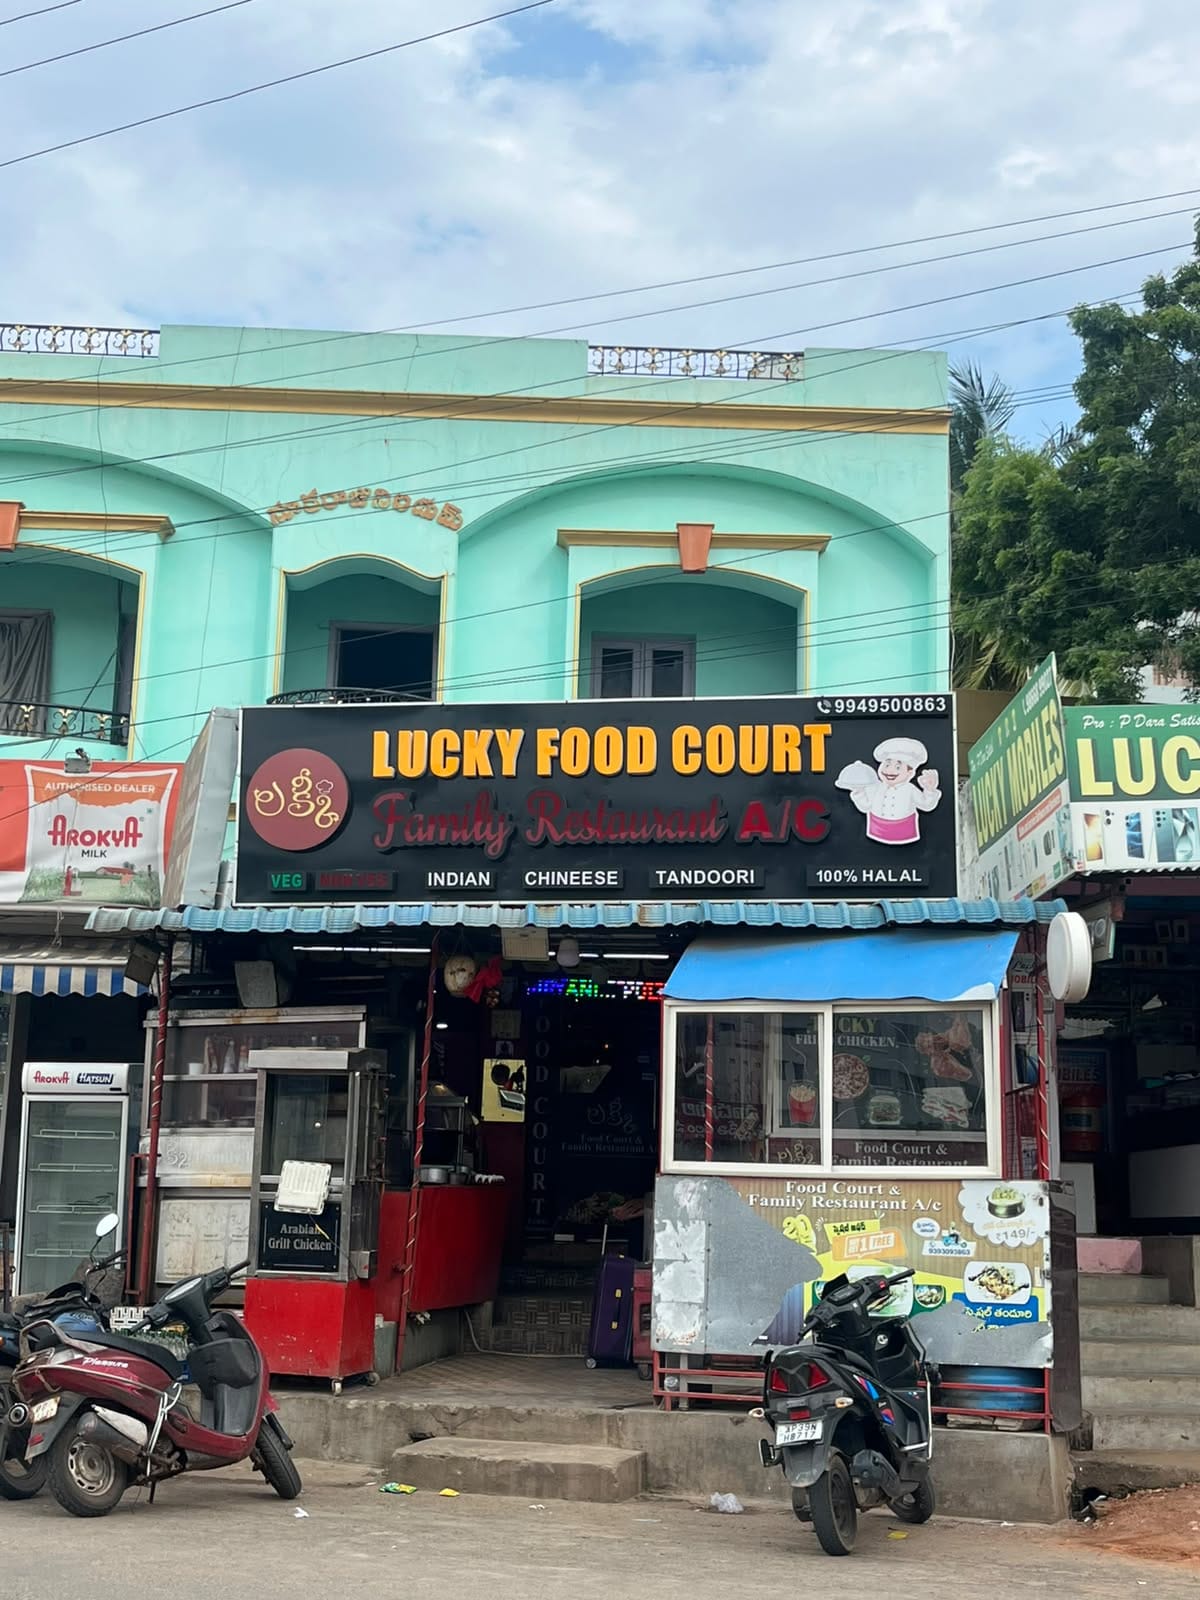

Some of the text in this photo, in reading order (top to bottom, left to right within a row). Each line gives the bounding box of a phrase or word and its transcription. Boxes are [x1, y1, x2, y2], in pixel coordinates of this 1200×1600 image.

[835, 697, 947, 713] 9949500863
[1083, 715, 1105, 729] Pro
[372, 723, 832, 778] LUCKY FOOD COURT
[972, 757, 1009, 844] LUCKY
[1006, 700, 1065, 816] MOBILES
[1076, 736, 1200, 797] LUC
[45, 781, 155, 793] AUTHORISED DEALER
[373, 790, 830, 857] Family Restaurant A/C
[81, 849, 107, 858] MILK
[271, 873, 303, 888] VEG
[428, 871, 491, 887] INDIAN
[525, 870, 619, 886] CHINEESE
[656, 870, 755, 885] TANDOORI
[816, 868, 922, 883] 100% HALAL
[78, 1072, 113, 1085] HATSUN
[855, 1141, 949, 1156] Food Court &
[786, 1181, 902, 1196] Food Court &
[748, 1193, 943, 1213] Family Restaurant A/c
[280, 1223, 321, 1235] Arabian
[268, 1237, 332, 1251] Grill Chicken
[81, 1356, 129, 1369] Pleasure
